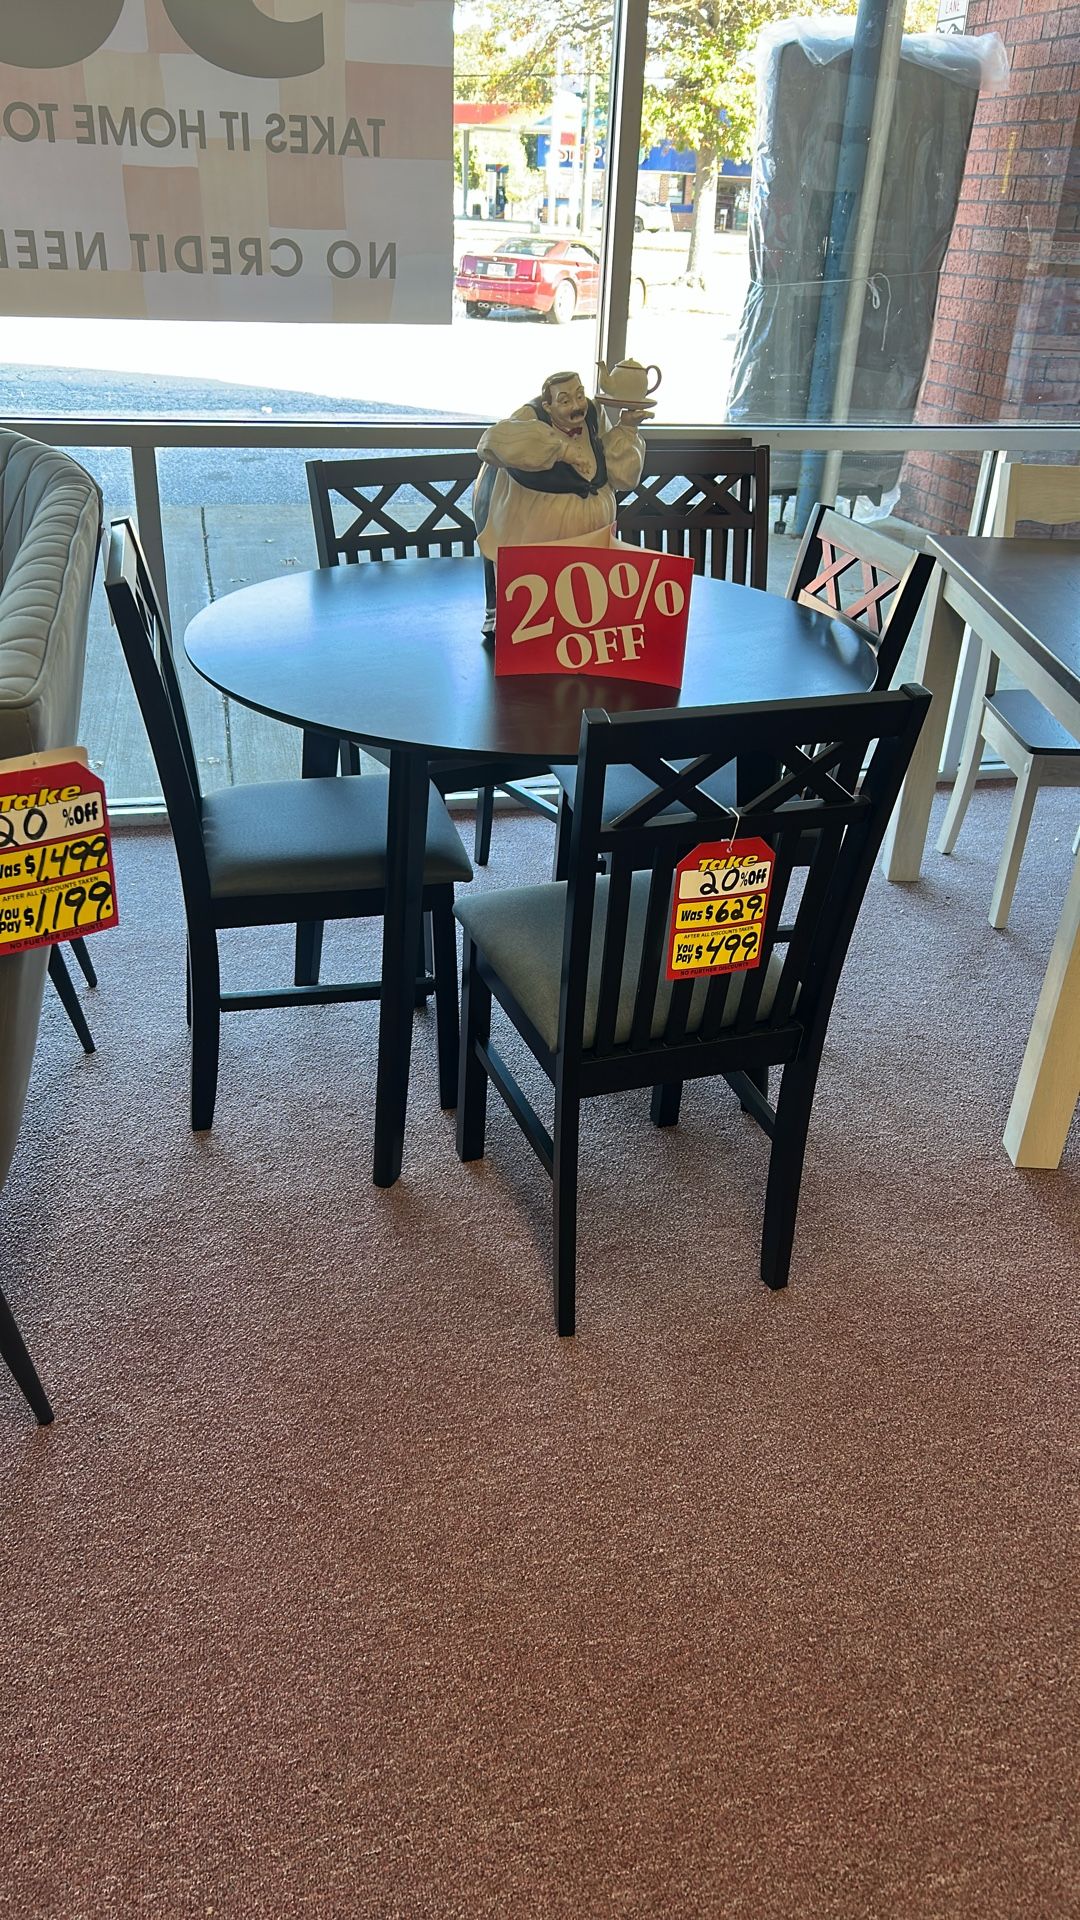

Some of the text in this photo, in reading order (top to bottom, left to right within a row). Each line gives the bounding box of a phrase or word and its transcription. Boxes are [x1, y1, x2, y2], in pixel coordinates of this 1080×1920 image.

[505, 558, 685, 645] 20%
[555, 623, 646, 670] OFF
[0, 785, 81, 813] Take
[0, 808, 48, 847] 20
[698, 855, 759, 872] Take
[2, 876, 99, 902] AFTER ALL DISCOUNTS TAKEN
[699, 868, 740, 896] 20
[680, 909, 704, 922] Was
[675, 953, 693, 964] Pay
[677, 943, 694, 954] You
